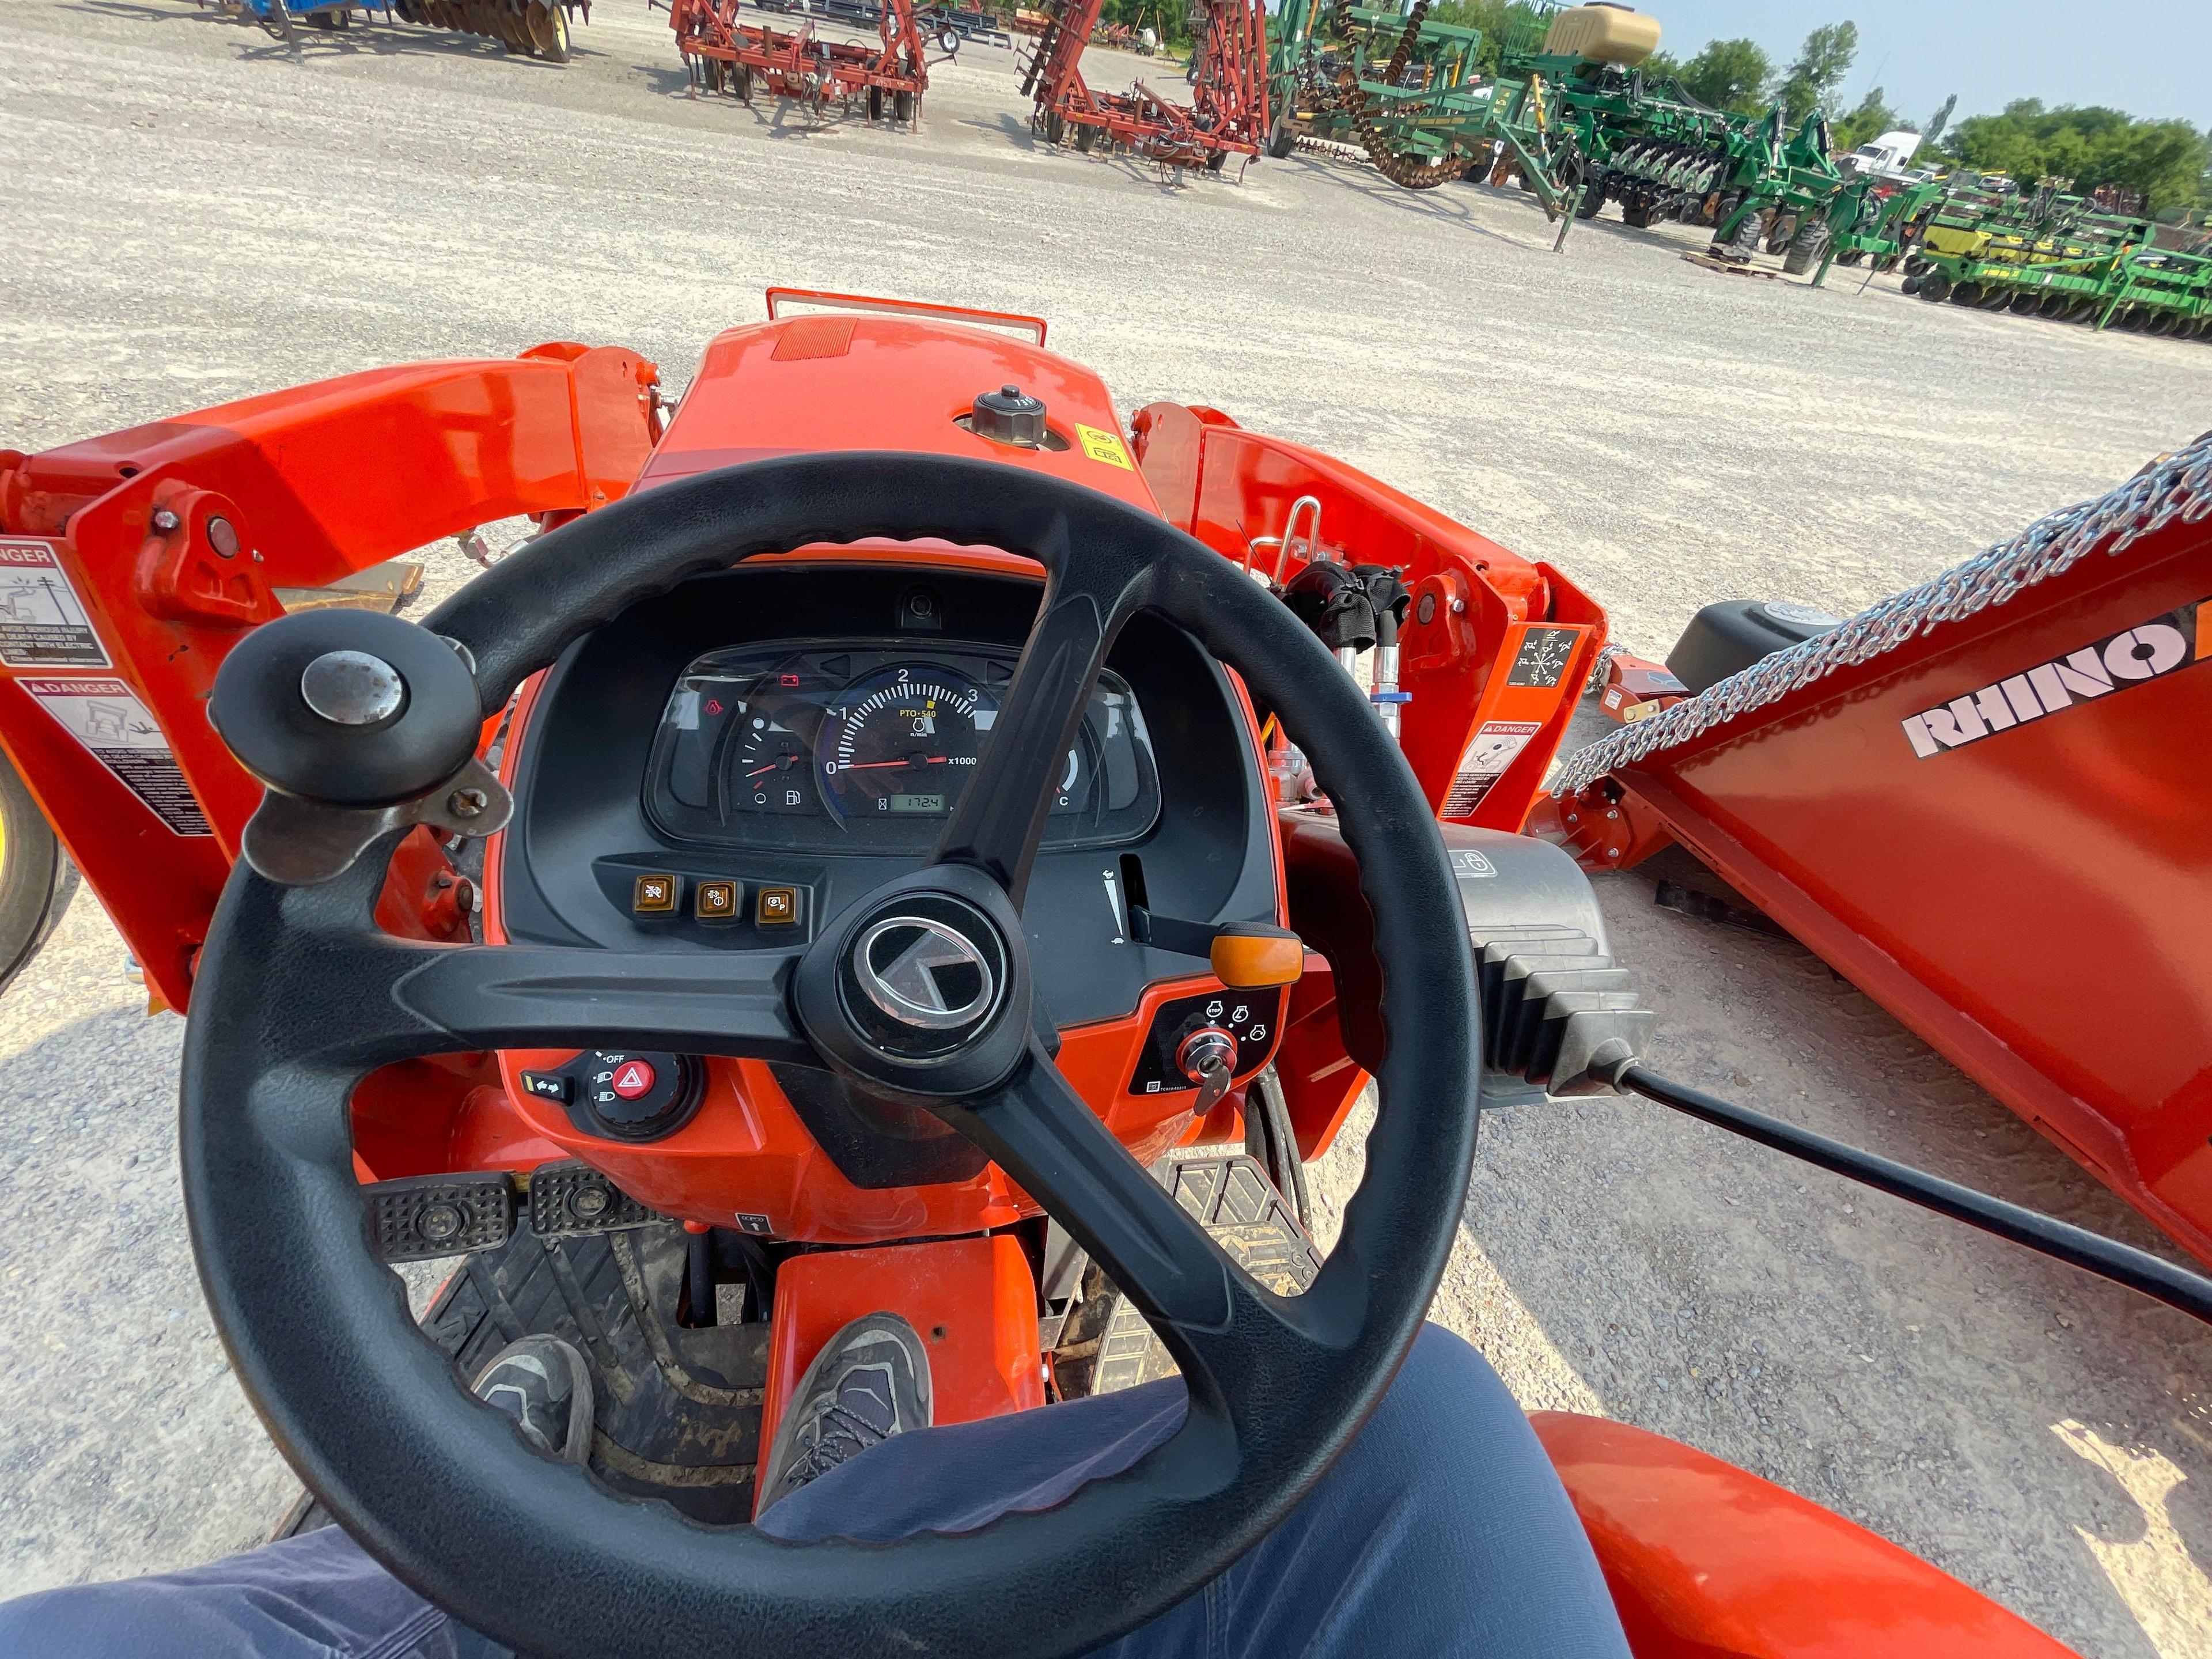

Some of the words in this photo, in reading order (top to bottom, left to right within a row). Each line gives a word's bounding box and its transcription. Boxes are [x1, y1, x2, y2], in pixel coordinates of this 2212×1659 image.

[898, 669, 908, 682] 2
[44, 683, 125, 693] DANGER
[1902, 624, 2187, 758] RHINO
[968, 689, 978, 702] 3
[839, 707, 846, 719] 1
[825, 761, 836, 775] 0
[1059, 797, 1068, 806] C
[607, 1055, 624, 1063] OFF
